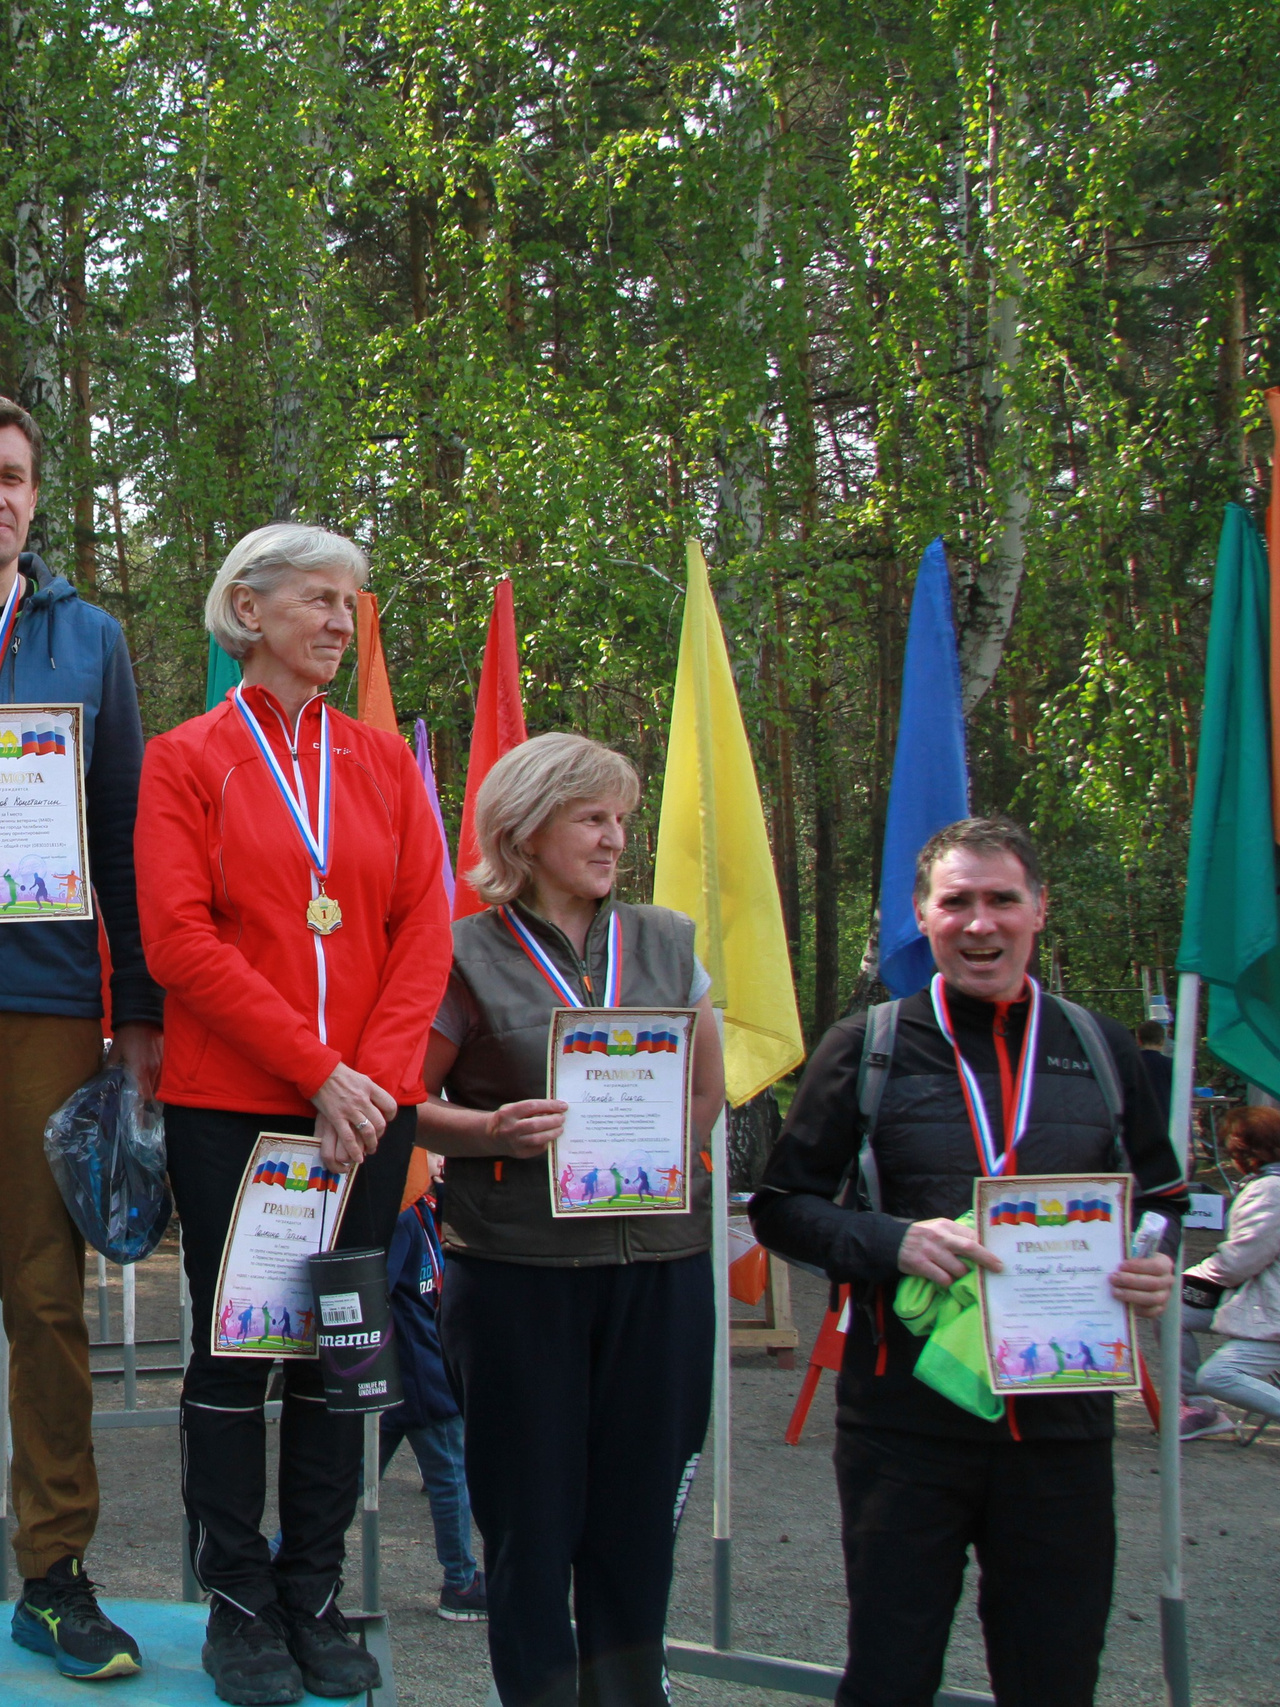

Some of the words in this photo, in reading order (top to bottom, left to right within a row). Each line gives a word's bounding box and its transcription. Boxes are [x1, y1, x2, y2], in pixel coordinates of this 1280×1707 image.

[322, 910, 327, 919] 1
[586, 1069, 654, 1080] ГРАМОТА
[263, 1202, 315, 1218] ГРАМОТА
[1185, 1209, 1212, 1218] АРТЫ
[319, 1330, 381, 1347] oname
